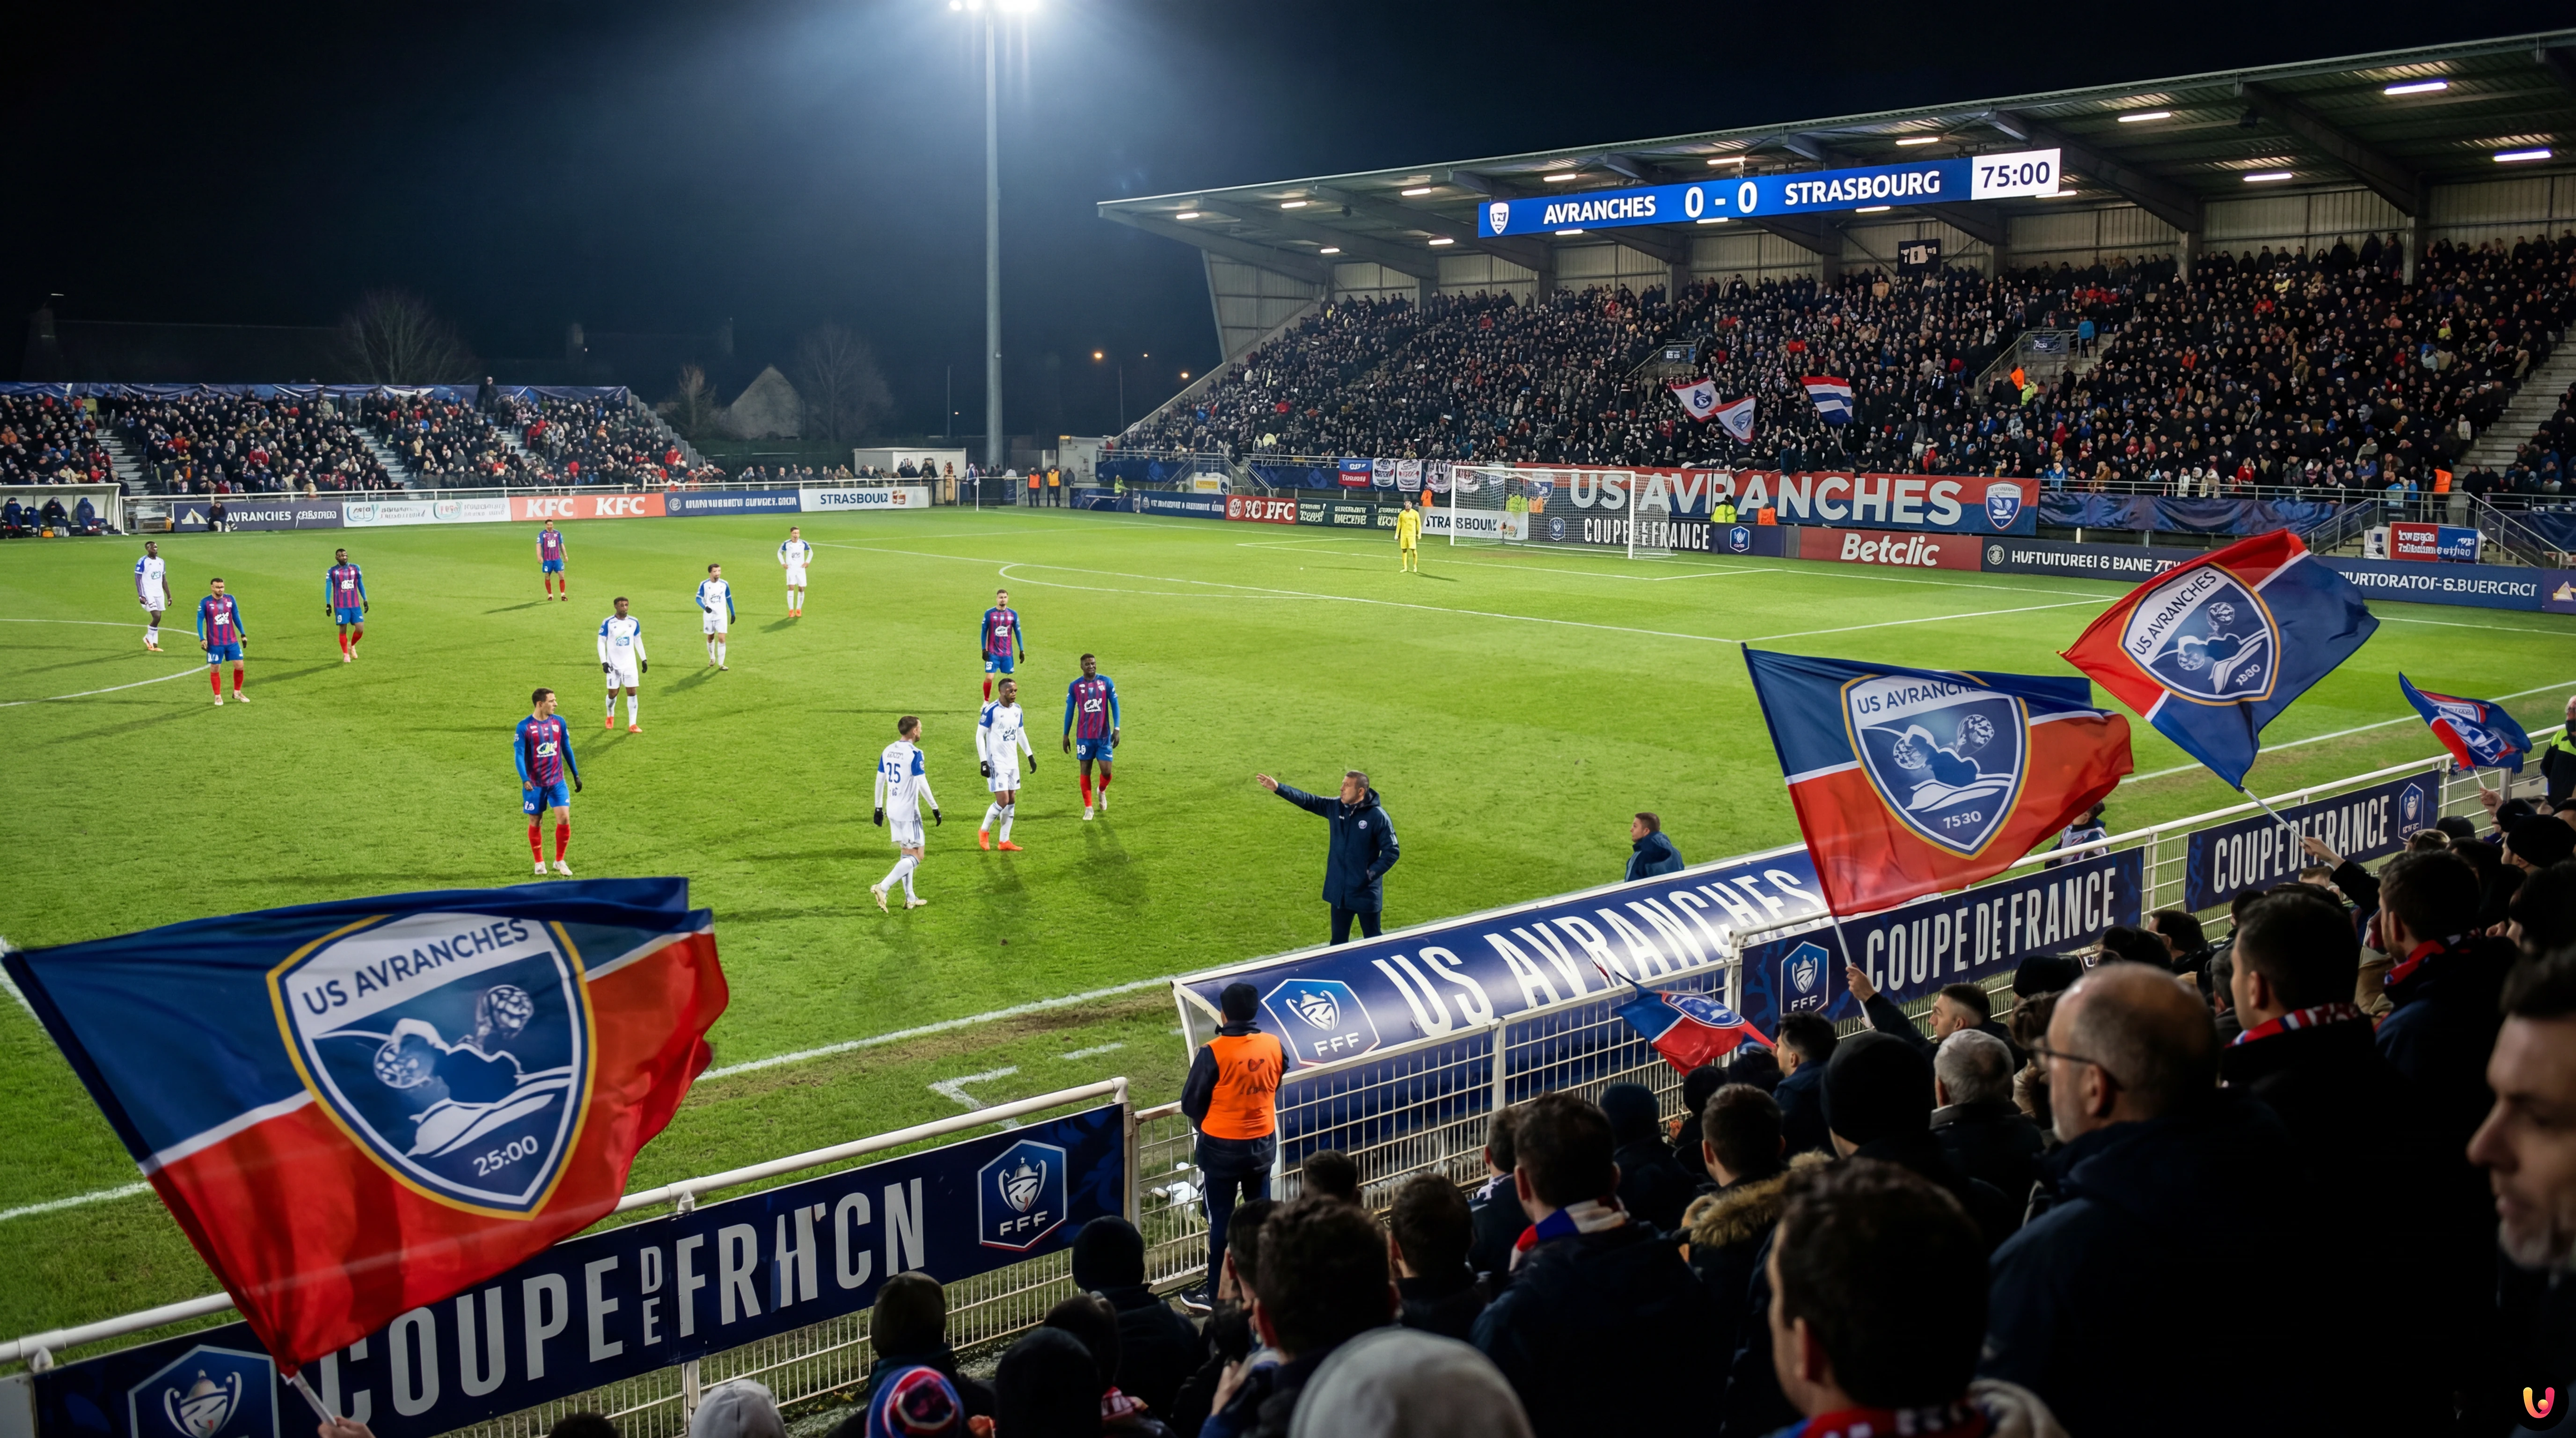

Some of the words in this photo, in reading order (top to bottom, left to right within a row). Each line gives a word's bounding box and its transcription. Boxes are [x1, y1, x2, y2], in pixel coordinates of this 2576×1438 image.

[1980, 161, 2051, 189] 75:00
[1544, 195, 1656, 224] AVRANCHES
[1685, 186, 1703, 219] 0
[1737, 181, 1758, 214] 0
[1785, 171, 1940, 206] STRASBOURG
[526, 499, 573, 518] KFC
[595, 497, 645, 515] KFC
[1569, 473, 1626, 509] US
[1638, 473, 1962, 525] AVRANCHES
[226, 511, 324, 522] AVRANCHES
[1584, 518, 1629, 543] COUPE
[1652, 521, 1710, 550] FRANCE
[1840, 533, 1940, 566] Betclic
[2133, 636, 2152, 655] US
[2147, 572, 2217, 640] AVRANCHES
[1857, 696, 1881, 714] US
[1887, 682, 1989, 709] AVRANC
[1943, 810, 1982, 829] 7530
[2213, 824, 2285, 894] COUPE
[2314, 794, 2389, 861] FRANCE
[1866, 907, 1969, 993] COUPE
[1976, 897, 2004, 966] DE
[2009, 867, 2116, 955] FRANCE
[303, 980, 348, 1015] US
[354, 918, 529, 998] AVRANCHES
[1371, 946, 1495, 1033] US
[1483, 869, 1826, 1009] AVRANCHES
[1791, 996, 1818, 1012] FFF
[1313, 1032, 1359, 1057] FFF
[472, 1135, 538, 1177] 25:00
[1000, 1211, 1048, 1236] FFF
[320, 1255, 623, 1427] COUPE
